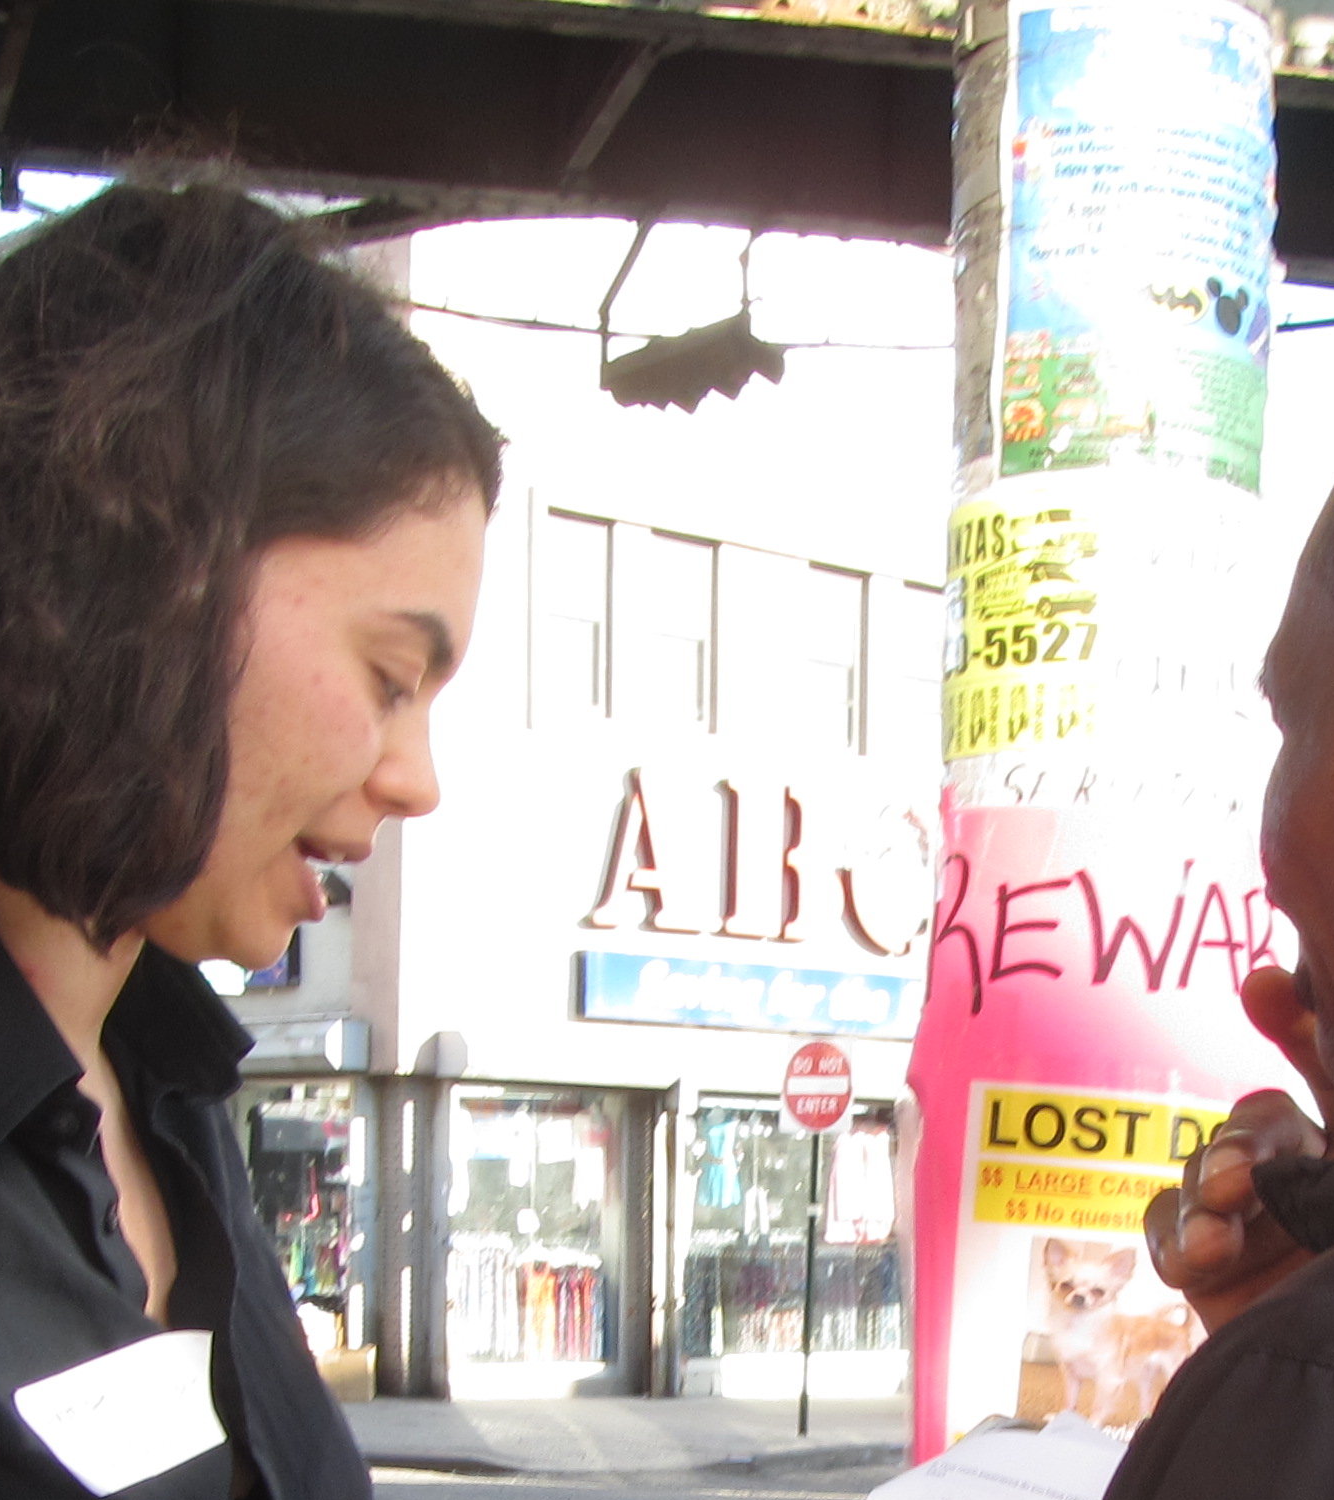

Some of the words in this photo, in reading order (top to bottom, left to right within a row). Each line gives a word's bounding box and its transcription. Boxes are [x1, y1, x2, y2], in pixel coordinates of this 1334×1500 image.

[793, 1056, 813, 1074] DO
[818, 1055, 844, 1074] NOT
[796, 1096, 839, 1115] ENTER
[988, 1100, 1151, 1157] LOST
[1013, 1170, 1093, 1197] LARGE
[1035, 1201, 1064, 1222] No
